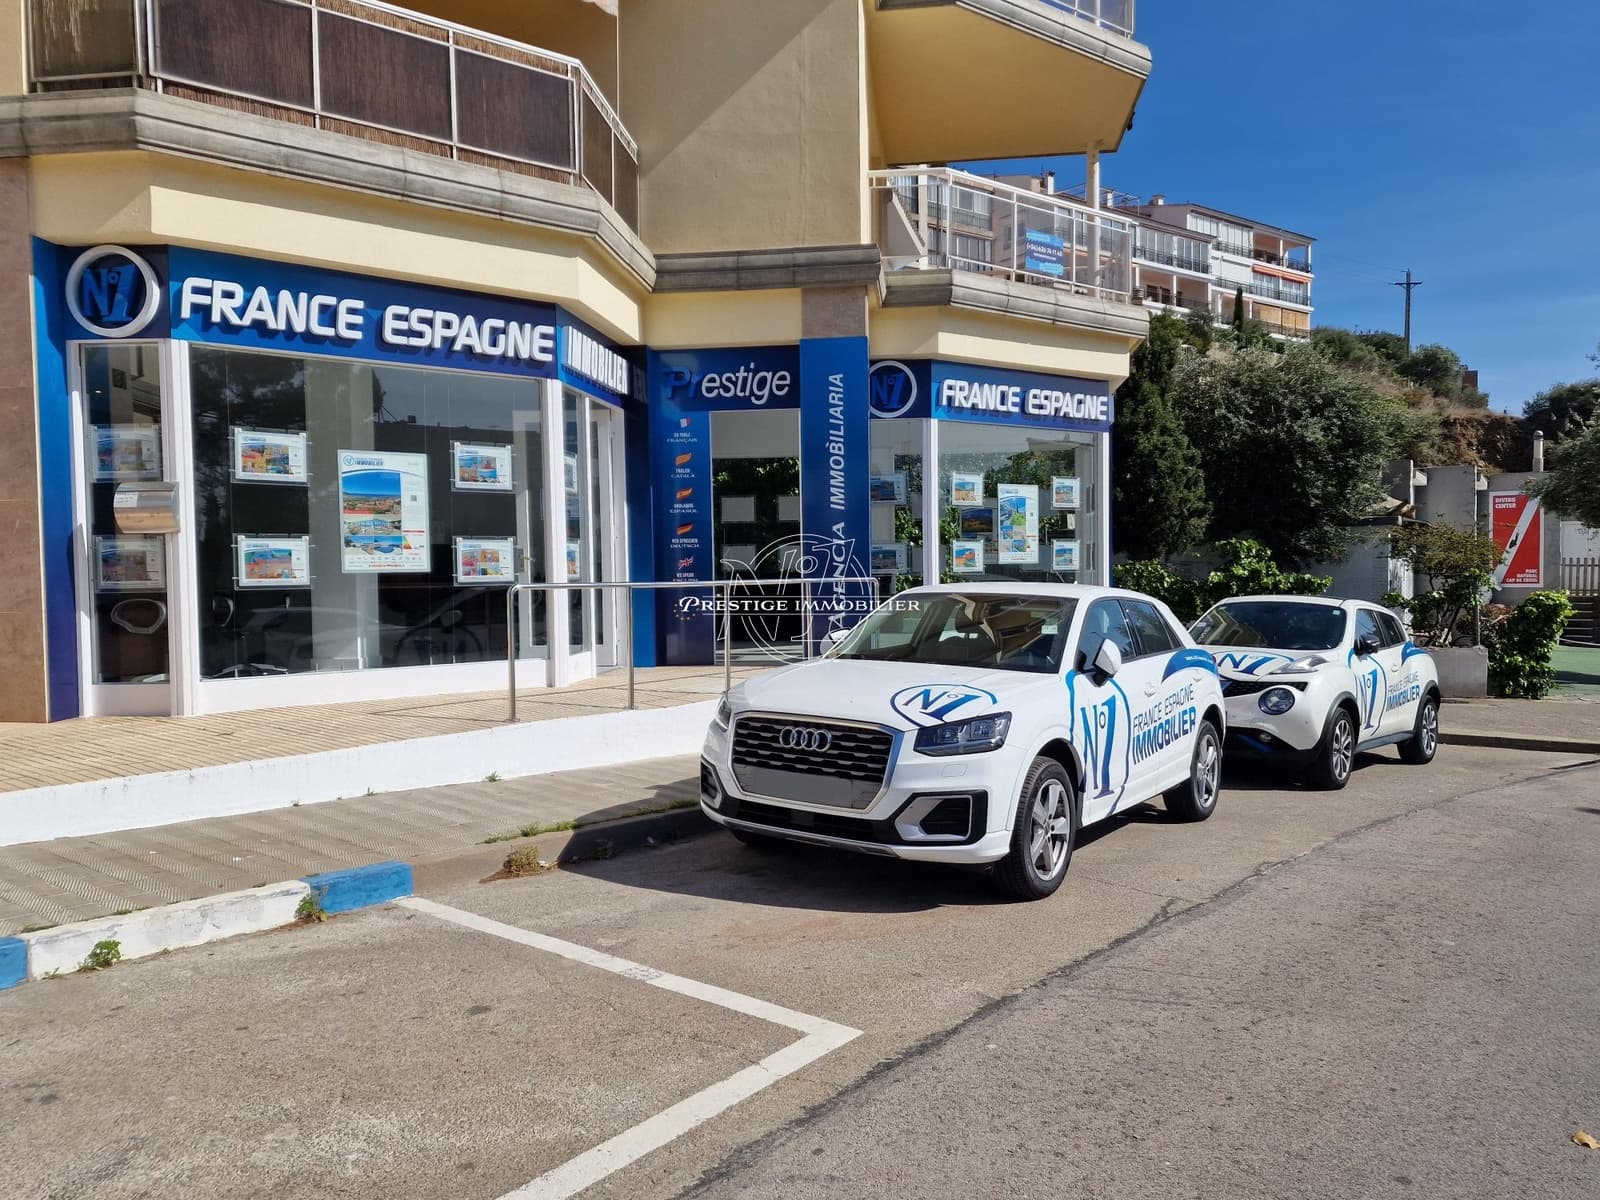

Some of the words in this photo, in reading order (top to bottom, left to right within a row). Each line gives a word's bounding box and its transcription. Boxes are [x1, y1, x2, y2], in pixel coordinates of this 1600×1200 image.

[180, 276, 365, 340] FRANCE
[382, 304, 556, 362] ESPAGNE
[564, 325, 629, 395] IMMOBILIER
[664, 361, 792, 405] Prestige
[941, 379, 1021, 413] FRANCE
[1025, 389, 1108, 421] ESPAGNE
[1132, 701, 1163, 733] FRANCE
[1164, 683, 1195, 715] ESPAGNE
[1132, 705, 1198, 765] IMMOBILIER
